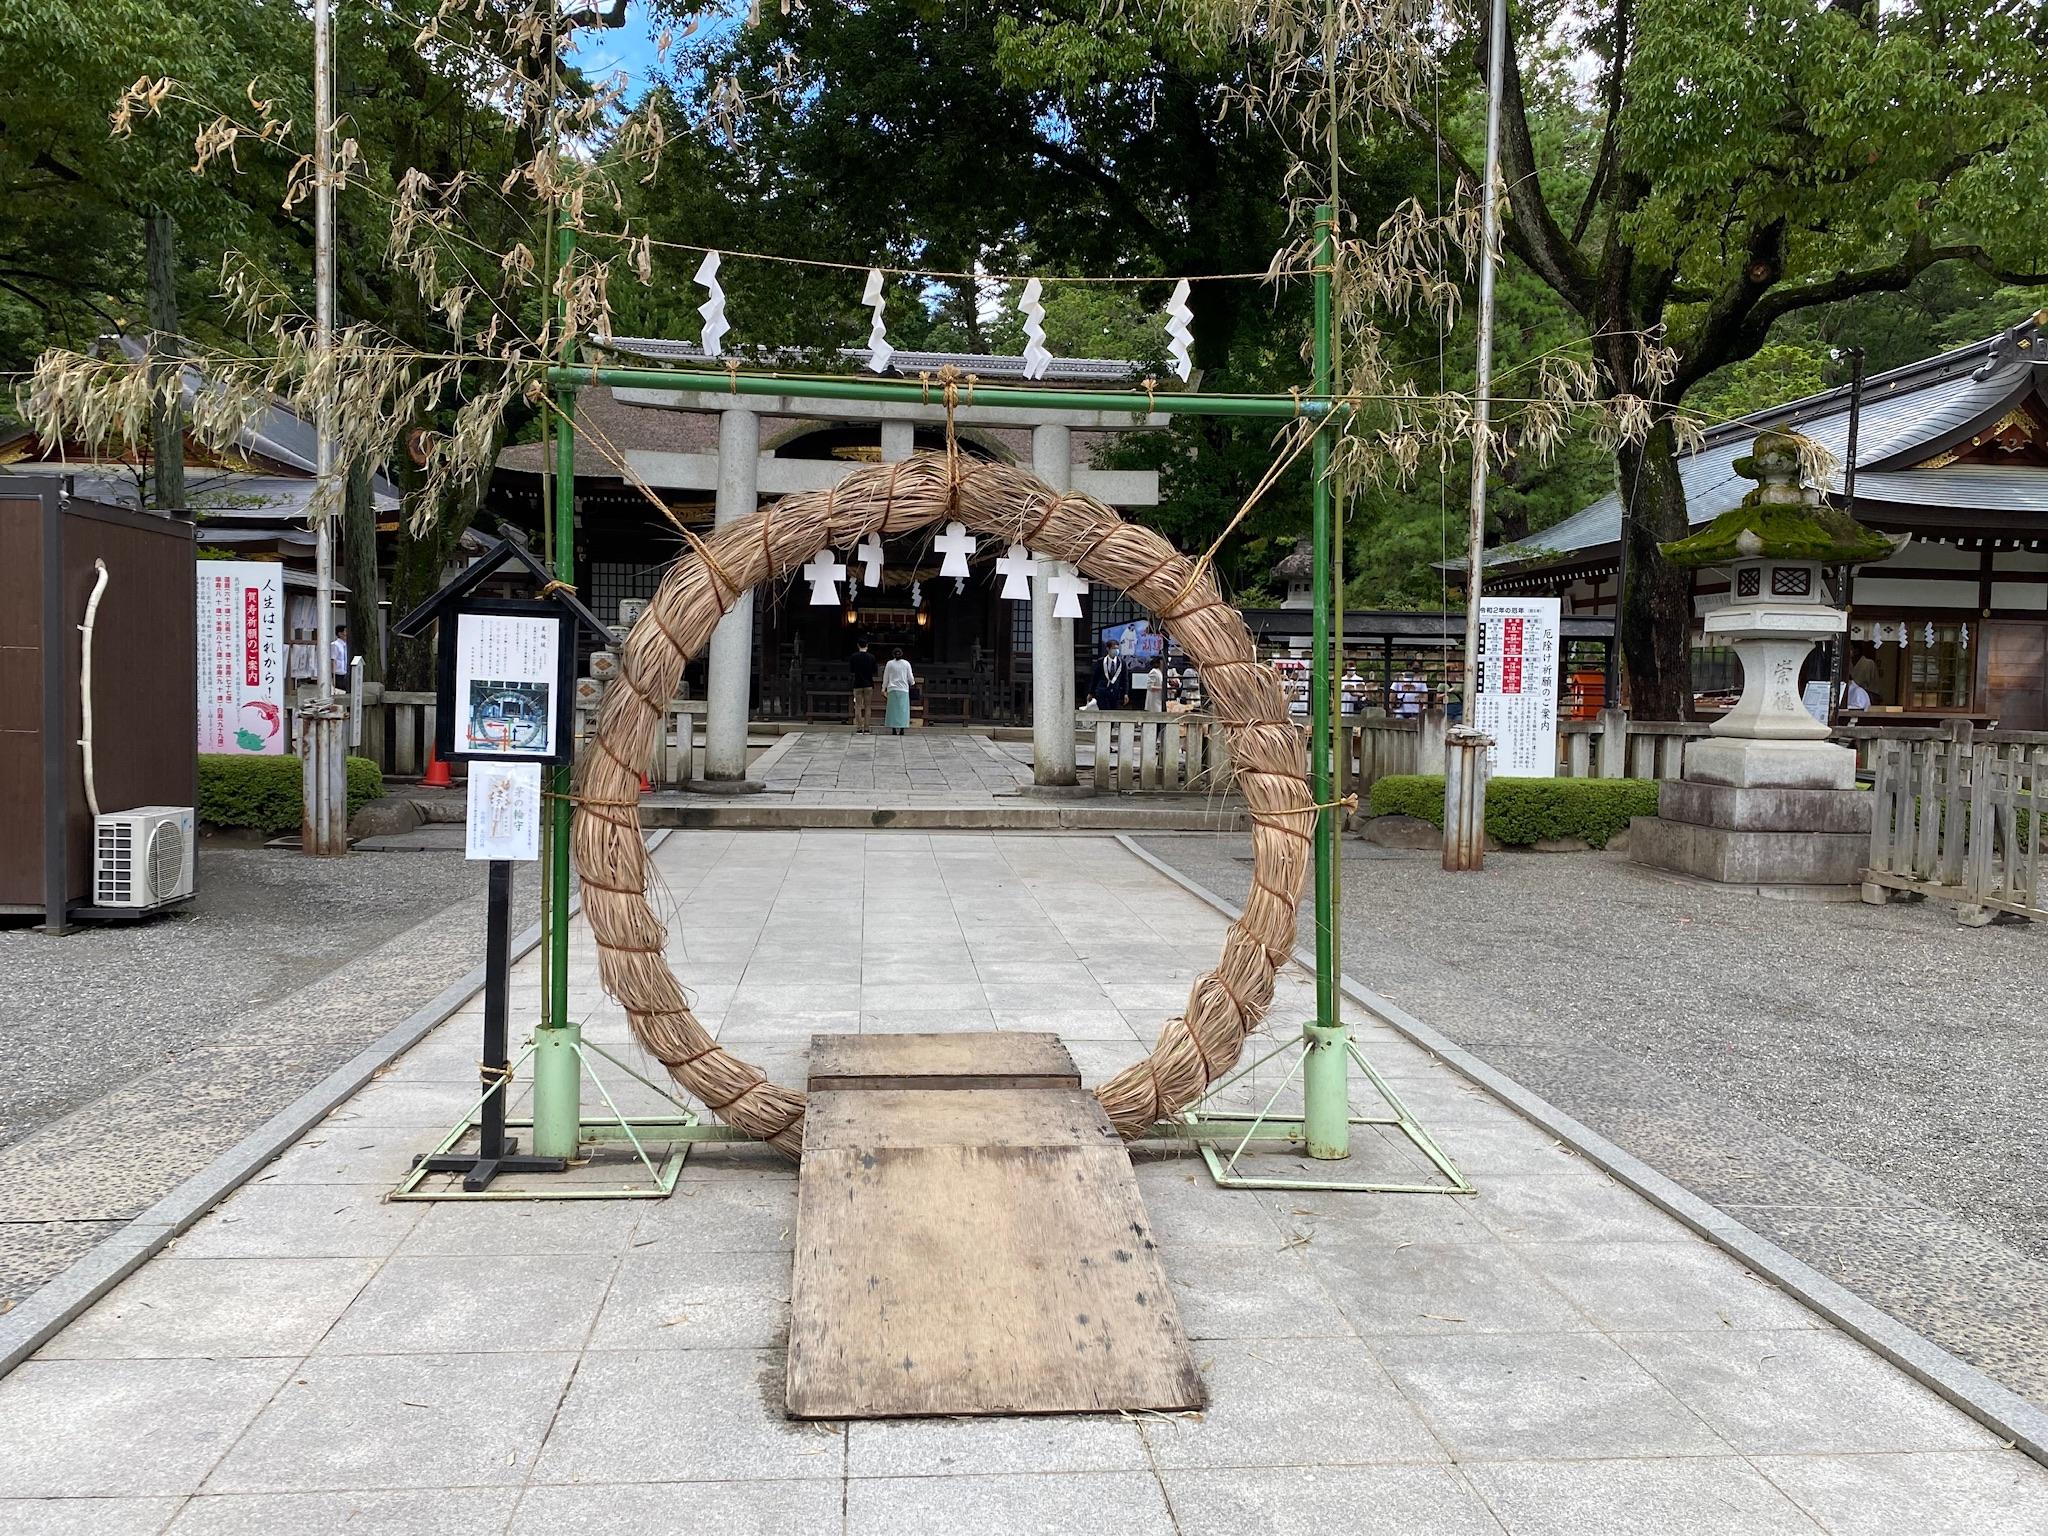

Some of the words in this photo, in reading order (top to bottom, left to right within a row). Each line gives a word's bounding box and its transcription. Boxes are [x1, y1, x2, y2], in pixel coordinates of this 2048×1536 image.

[246, 591, 258, 683] 賀寿祈願のご案内
[1540, 629, 1553, 732] 厄除け祈願のご案内
